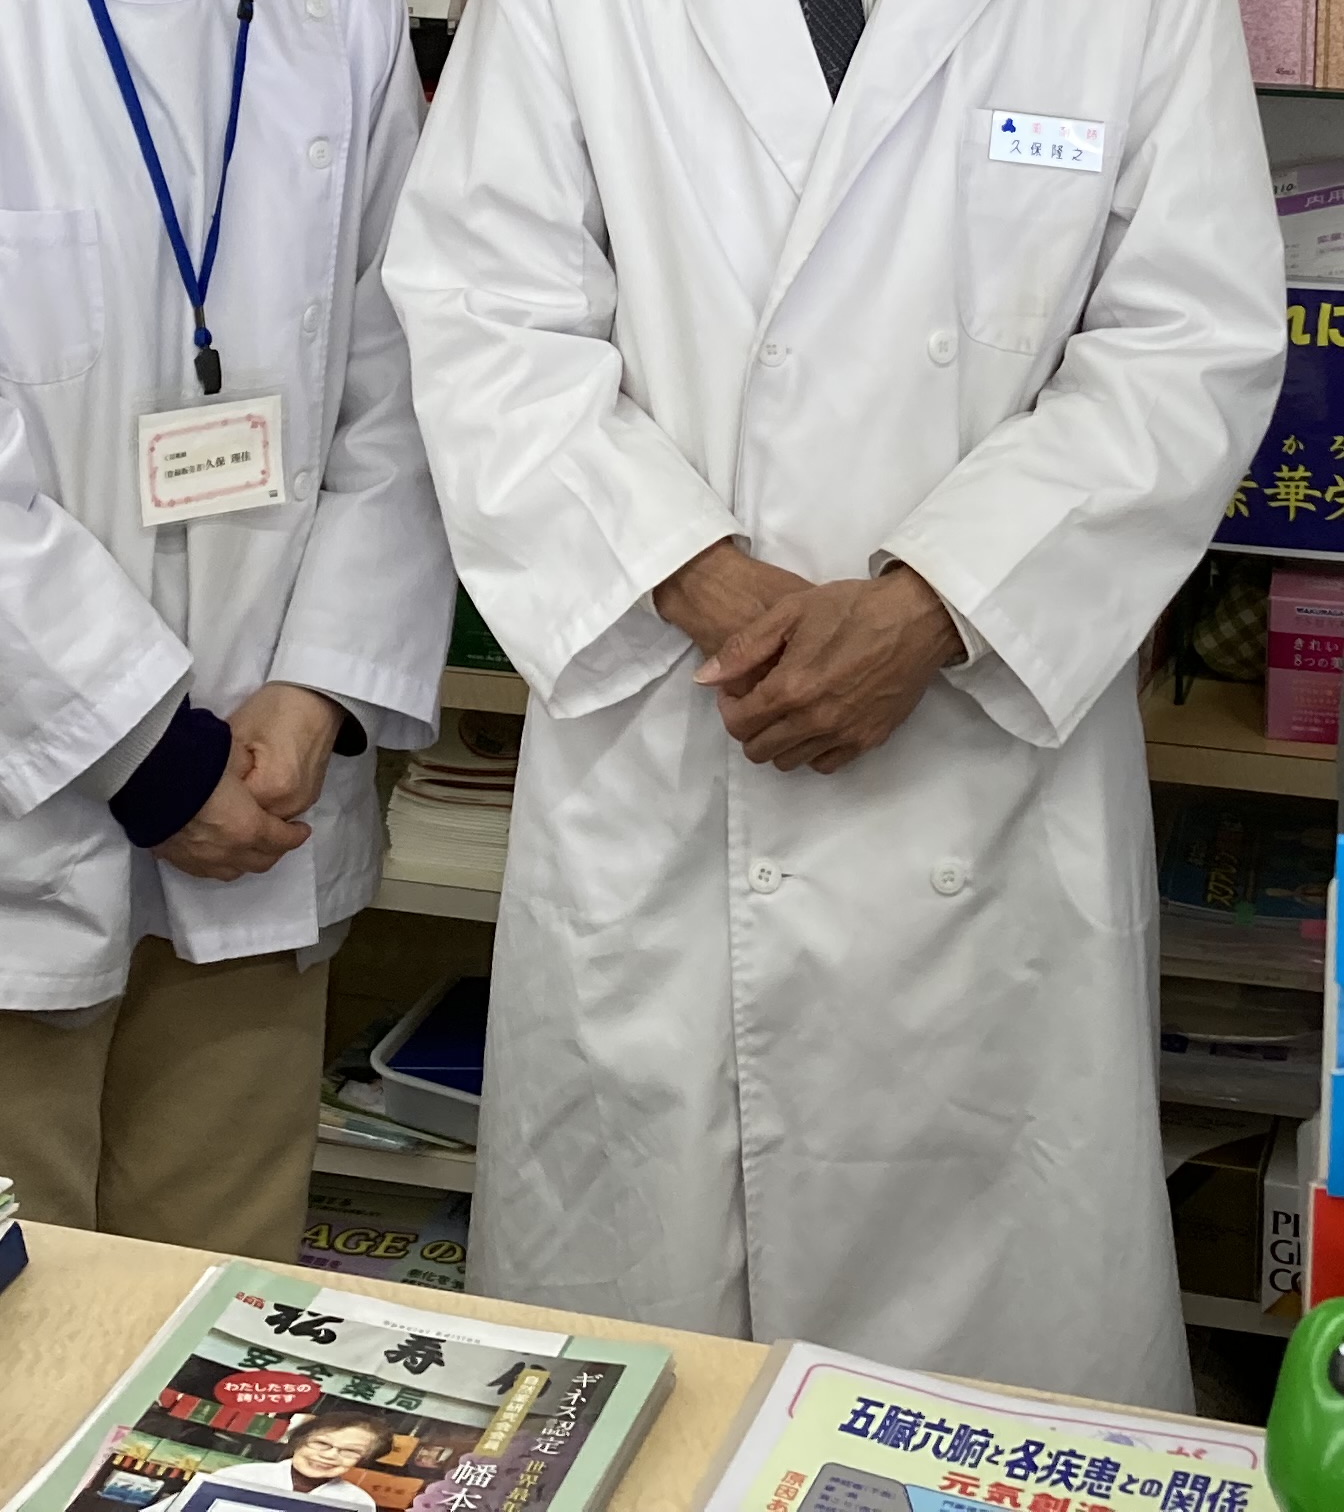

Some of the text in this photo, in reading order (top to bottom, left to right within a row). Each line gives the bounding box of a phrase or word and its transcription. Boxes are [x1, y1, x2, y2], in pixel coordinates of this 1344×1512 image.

[1009, 139, 1084, 162] 久保隆之
[303, 1223, 419, 1259] AGE
[223, 1381, 312, 1394] わたしたちの
[238, 1345, 426, 1412] 安全薬局
[236, 1392, 296, 1405] 誇りです
[531, 1370, 604, 1456] ギネス認定
[837, 1395, 1254, 1512] 五臓六腑と各疾患との関係
